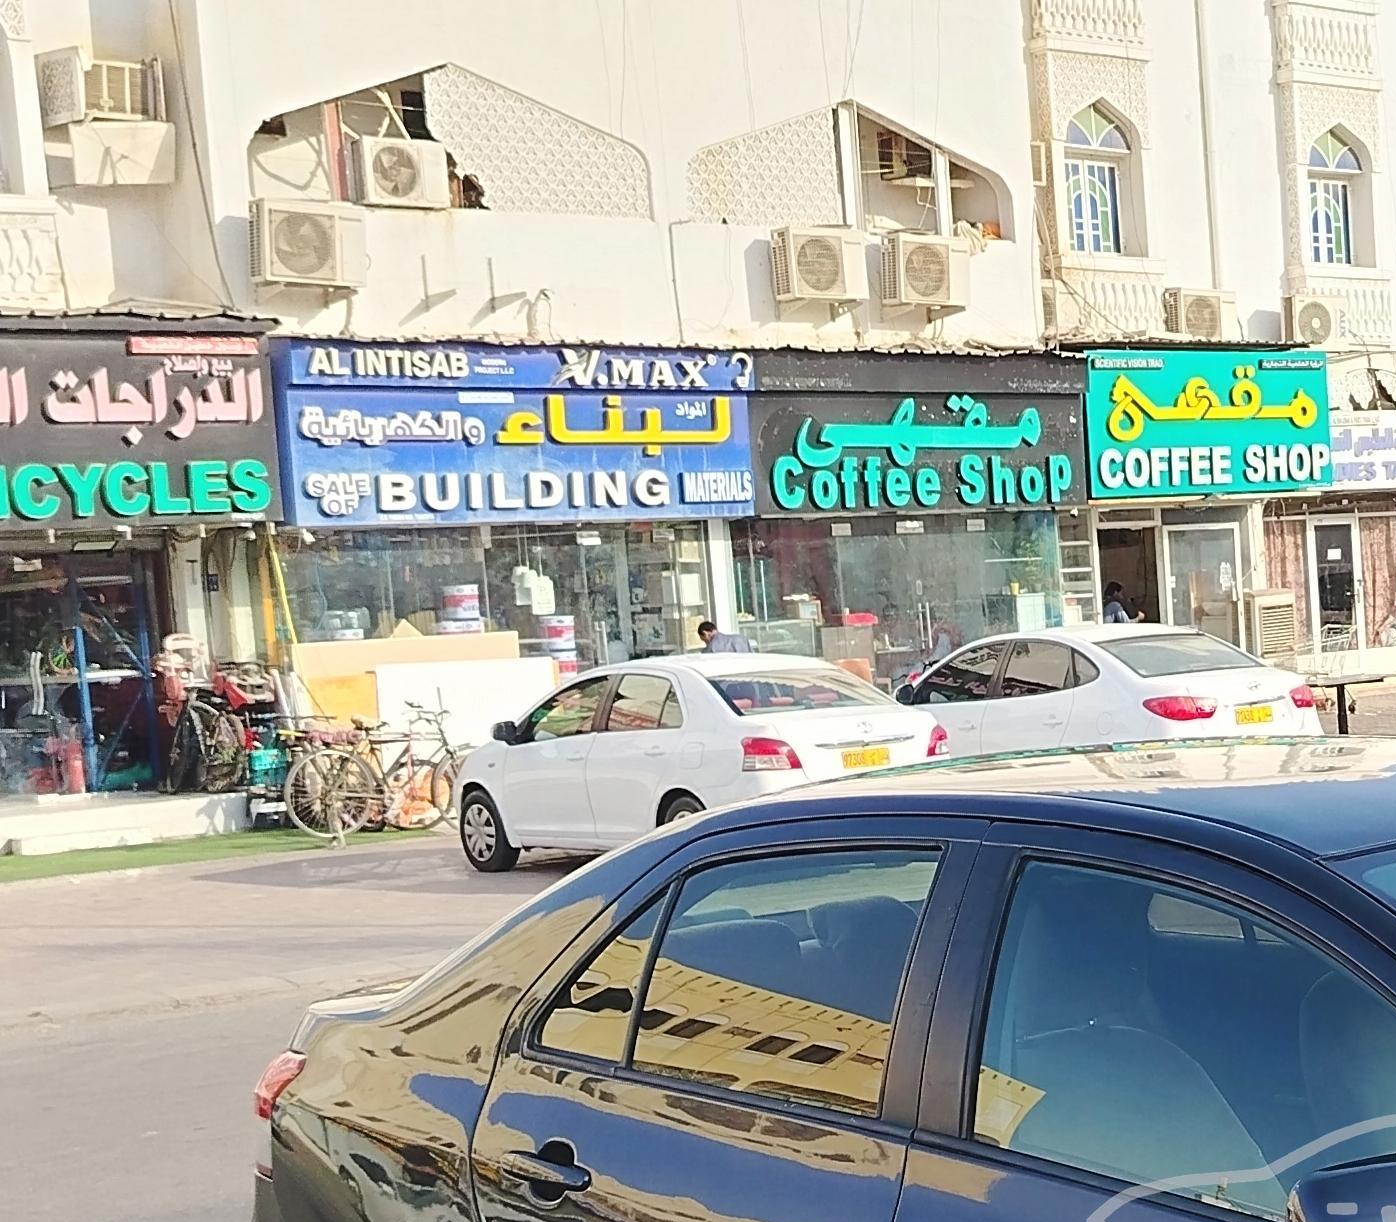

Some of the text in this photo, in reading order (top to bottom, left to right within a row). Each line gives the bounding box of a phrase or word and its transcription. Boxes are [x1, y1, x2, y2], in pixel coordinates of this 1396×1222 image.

[309, 347, 470, 379] AL INTISAB
[45, 366, 264, 447] الدراجات
[309, 477, 370, 497] SALE
[772, 455, 941, 510] Coffee
[1098, 442, 1331, 489] COFFEE SHOP
[1334, 461, 1377, 482] DIES
[0, 459, 272, 520] ICYCLES
[325, 497, 357, 515] OF
[378, 468, 753, 512] BUILDING MATERIALS
